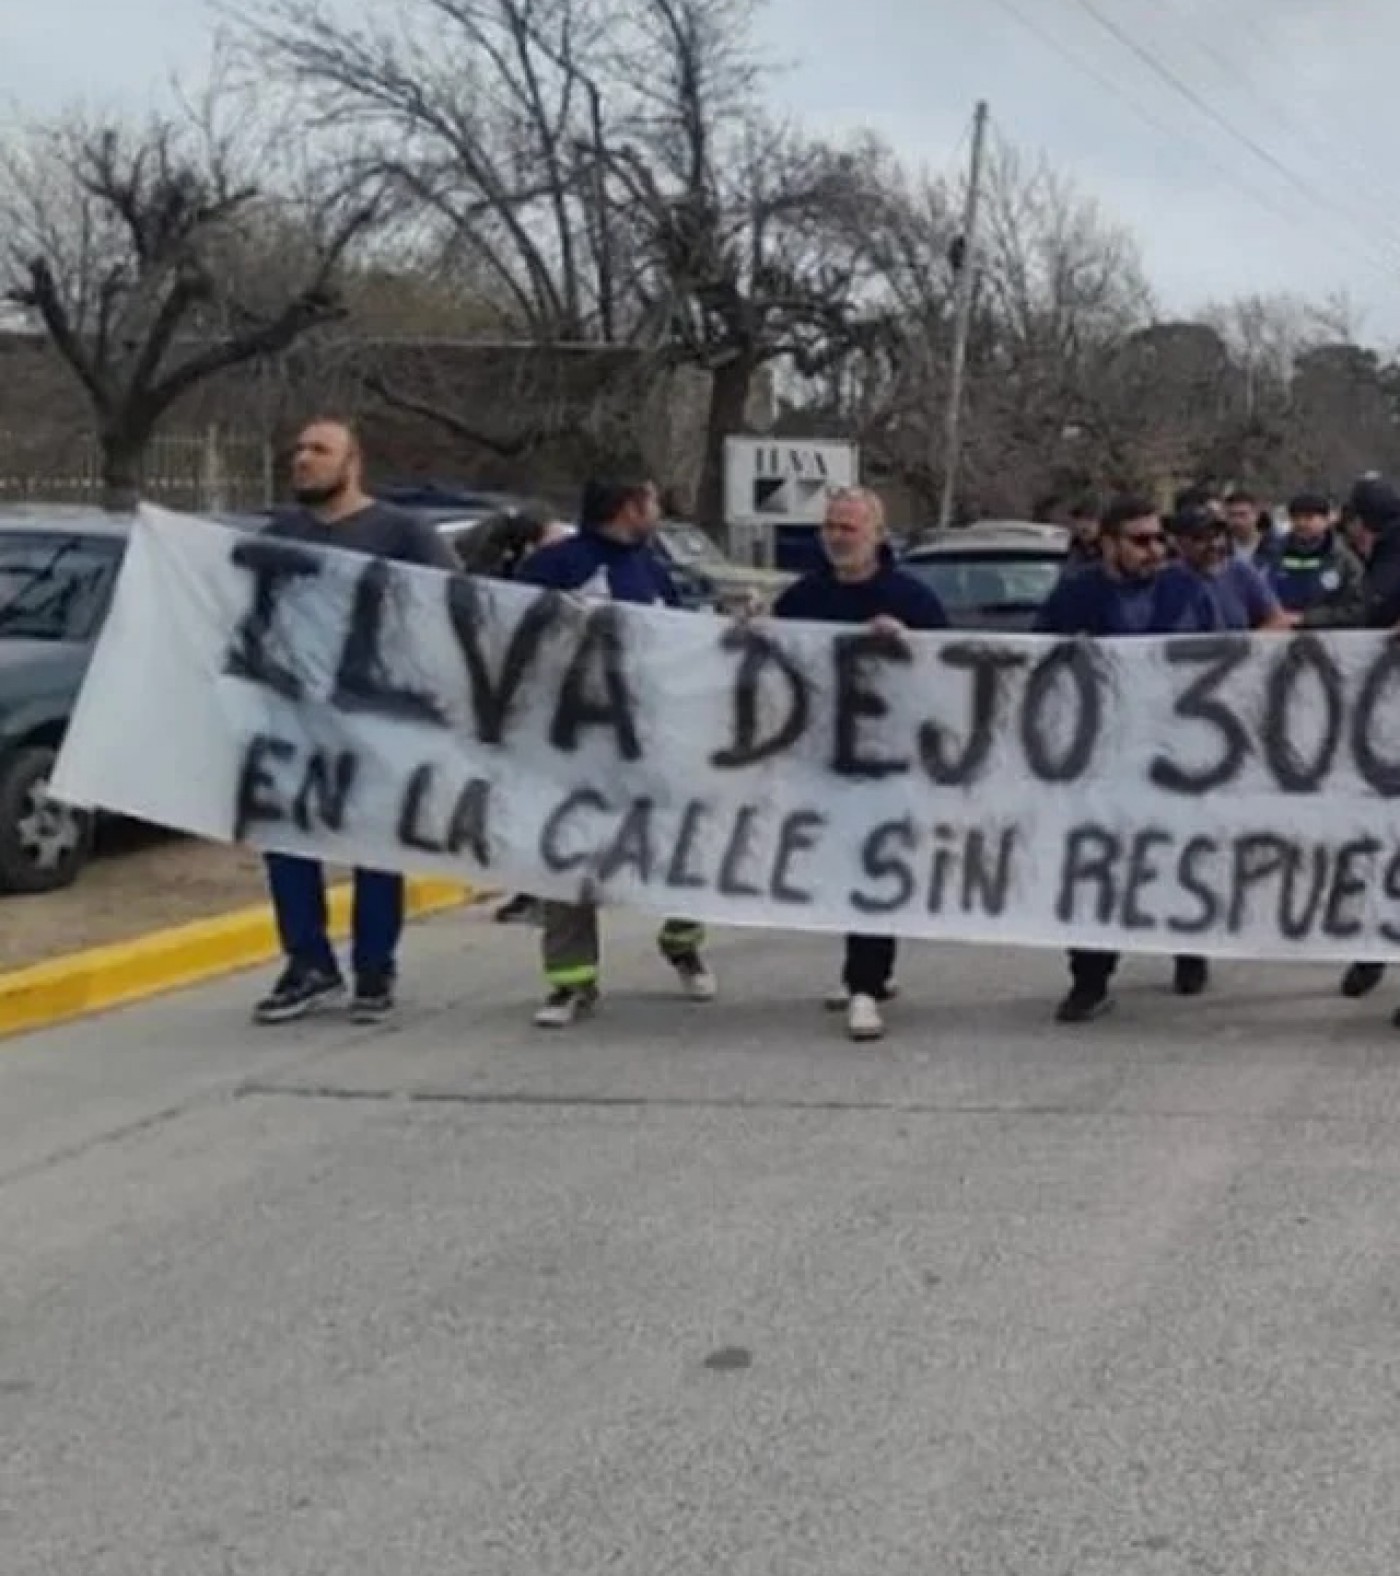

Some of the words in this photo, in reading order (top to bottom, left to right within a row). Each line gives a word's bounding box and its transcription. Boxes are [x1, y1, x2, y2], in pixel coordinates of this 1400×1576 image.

[225, 541, 643, 762] ILVA
[712, 630, 1100, 785] DEJO
[233, 733, 358, 842] EN
[397, 763, 490, 868] LA
[540, 788, 826, 904] CALLE
